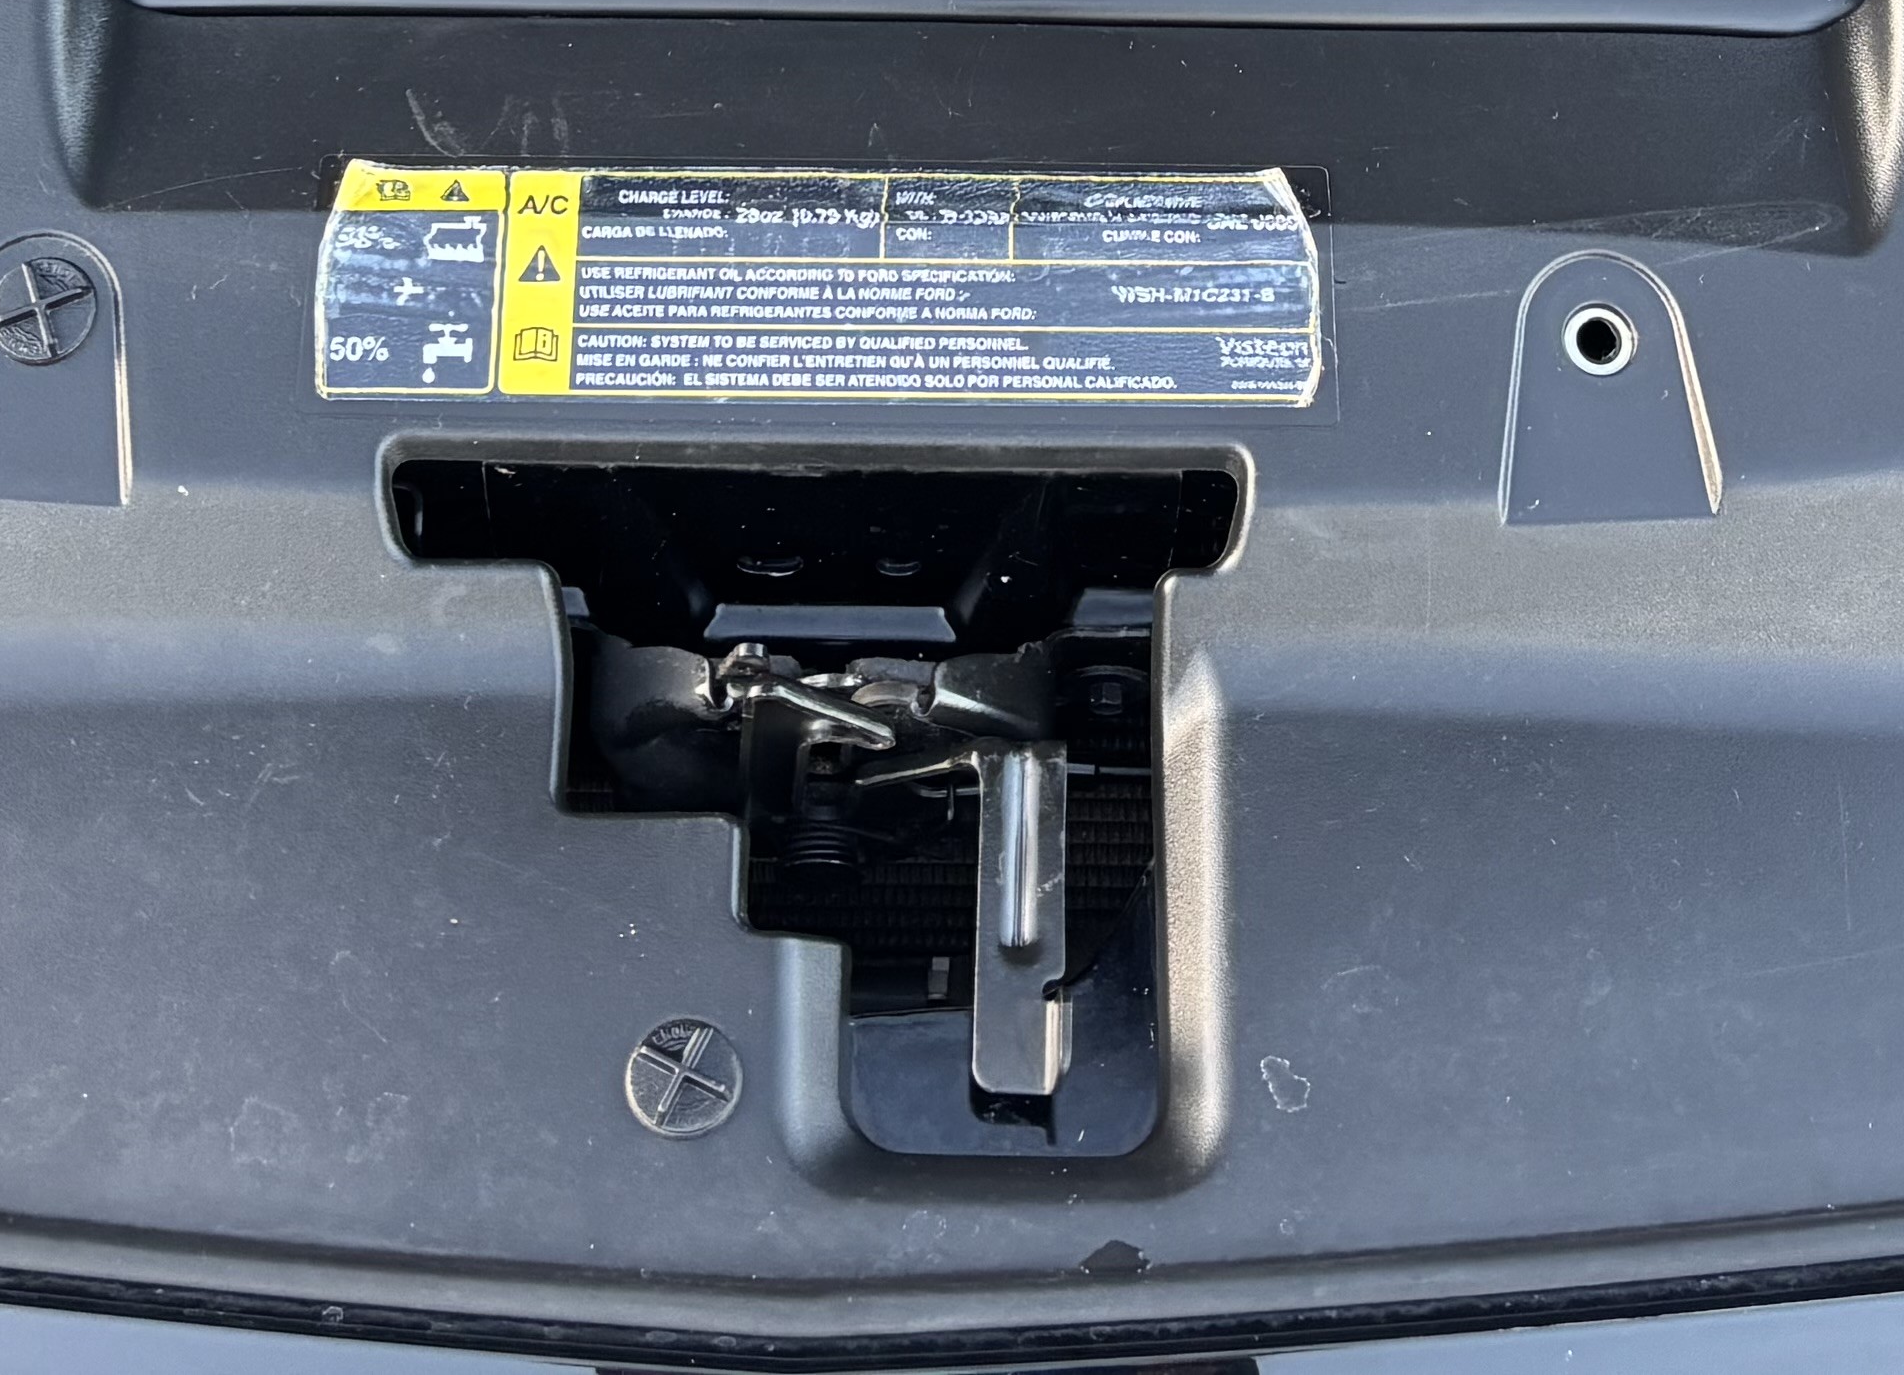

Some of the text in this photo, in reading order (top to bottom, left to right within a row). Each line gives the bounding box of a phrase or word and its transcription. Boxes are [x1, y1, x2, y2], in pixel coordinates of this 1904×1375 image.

[518, 194, 570, 216] A/C
[618, 189, 731, 205] CHARGE LEVEL:
[581, 226, 633, 239] CARGA
[635, 226, 656, 238] DE
[896, 227, 933, 241] CON:
[1164, 230, 1201, 244] CON:
[581, 266, 612, 280] USE
[614, 267, 717, 281] REFRIGERANT
[719, 268, 744, 282] OIL
[745, 269, 834, 282] ACCORDING
[858, 269, 898, 282] FORD
[579, 285, 645, 300] UTILISER
[648, 286, 735, 300] LUBRIFIANT
[736, 286, 820, 301] CONFORME
[822, 282, 834, 300] À
[837, 287, 856, 300] LA
[859, 287, 912, 301] NORME
[915, 288, 955, 302] FORD
[578, 304, 610, 319] USE
[611, 304, 665, 319] ACEITE
[668, 305, 708, 319] PARA
[710, 305, 832, 320] REFRIGERANTES
[835, 306, 918, 321] CONFORME
[935, 307, 988, 321] NORMA
[991, 307, 1037, 321] FORD:
[329, 336, 390, 362] 50%
[577, 334, 1029, 352] CAUTION: SYSTEM TO BE SERVICED BY QUALIFIED PERSONNEL.
[576, 353, 613, 368] MISE
[615, 354, 636, 368] EN
[639, 354, 692, 368] GARDE
[702, 354, 723, 368] NE
[725, 354, 790, 369] CONFIER
[793, 355, 887, 370] L'ENTRETIEN
[928, 356, 949, 370] UN
[953, 356, 1040, 371] PERSONNEL
[1042, 354, 1116, 371] QUALIFIÉ.
[576, 371, 1178, 391] PRECAUCIÓN: EL SISTEMA DEBE SER ATENDIDO SOLO POR PERSONAL CALIFICADO.
